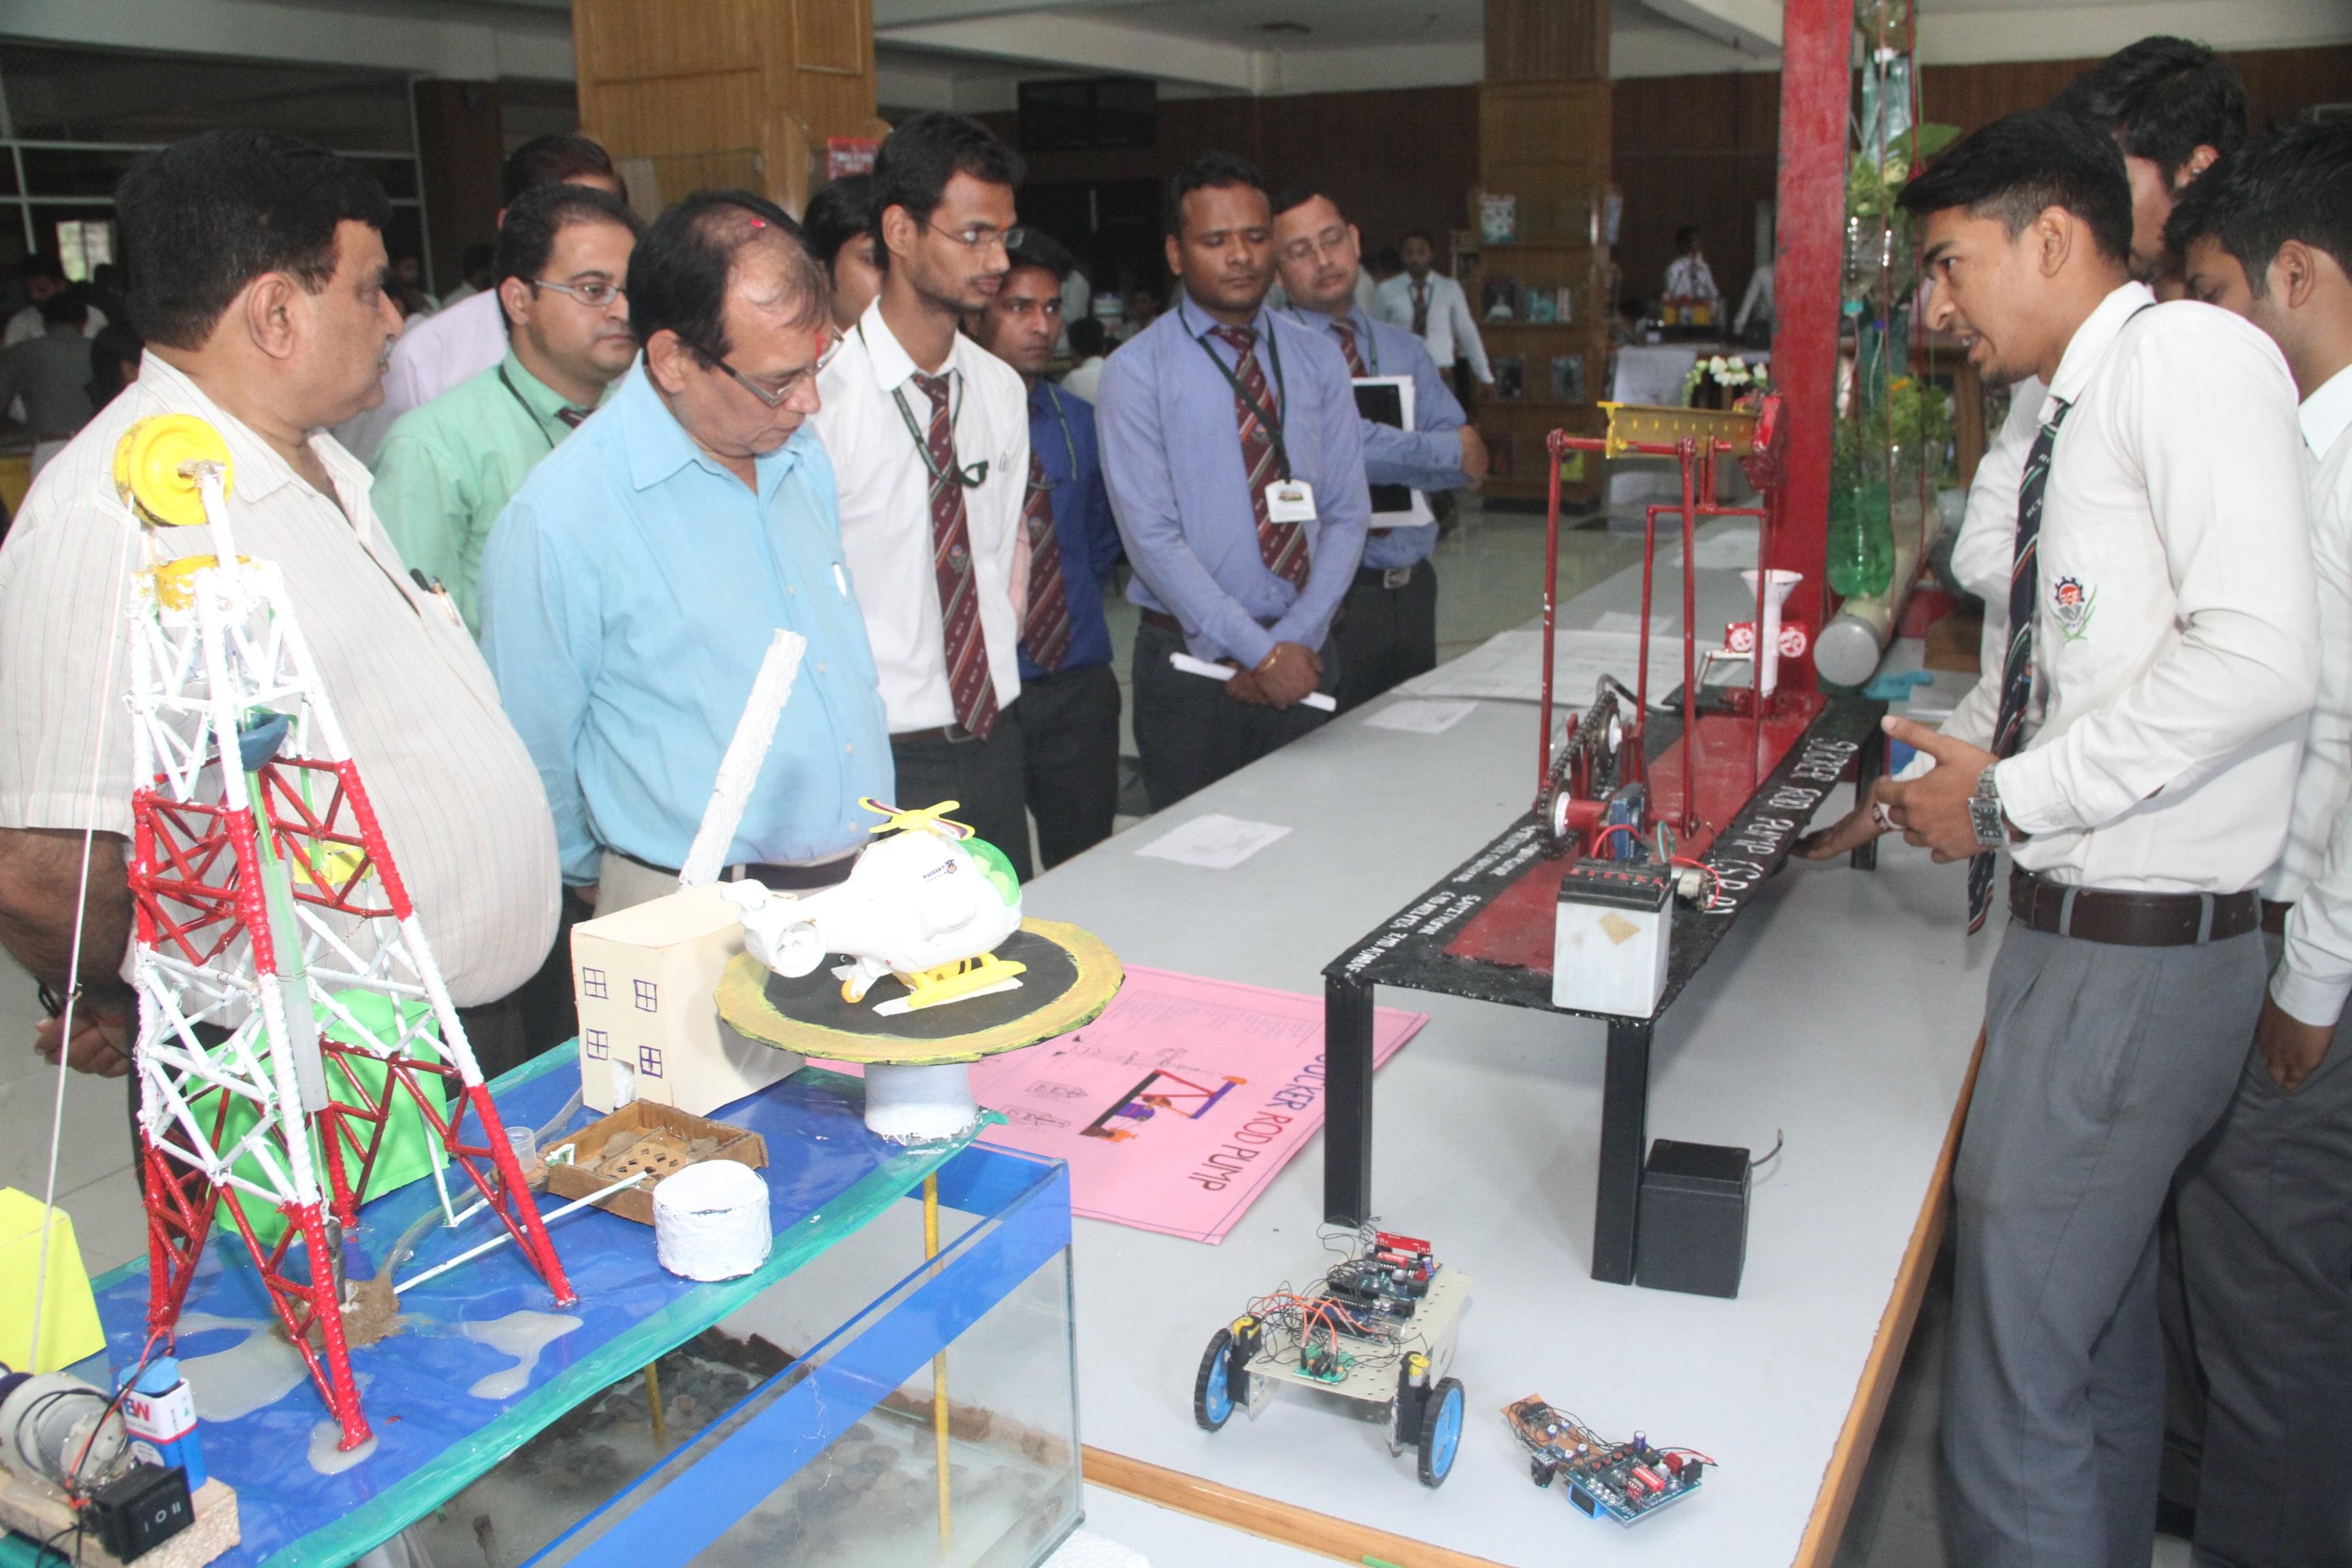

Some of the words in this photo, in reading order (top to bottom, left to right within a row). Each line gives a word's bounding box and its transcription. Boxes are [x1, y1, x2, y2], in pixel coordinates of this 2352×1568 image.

[1732, 816, 1795, 855] PUMP
[1264, 1053, 1326, 1111] UCKER
[1234, 1110, 1293, 1145] ROD
[1188, 1144, 1261, 1192] PUMP
